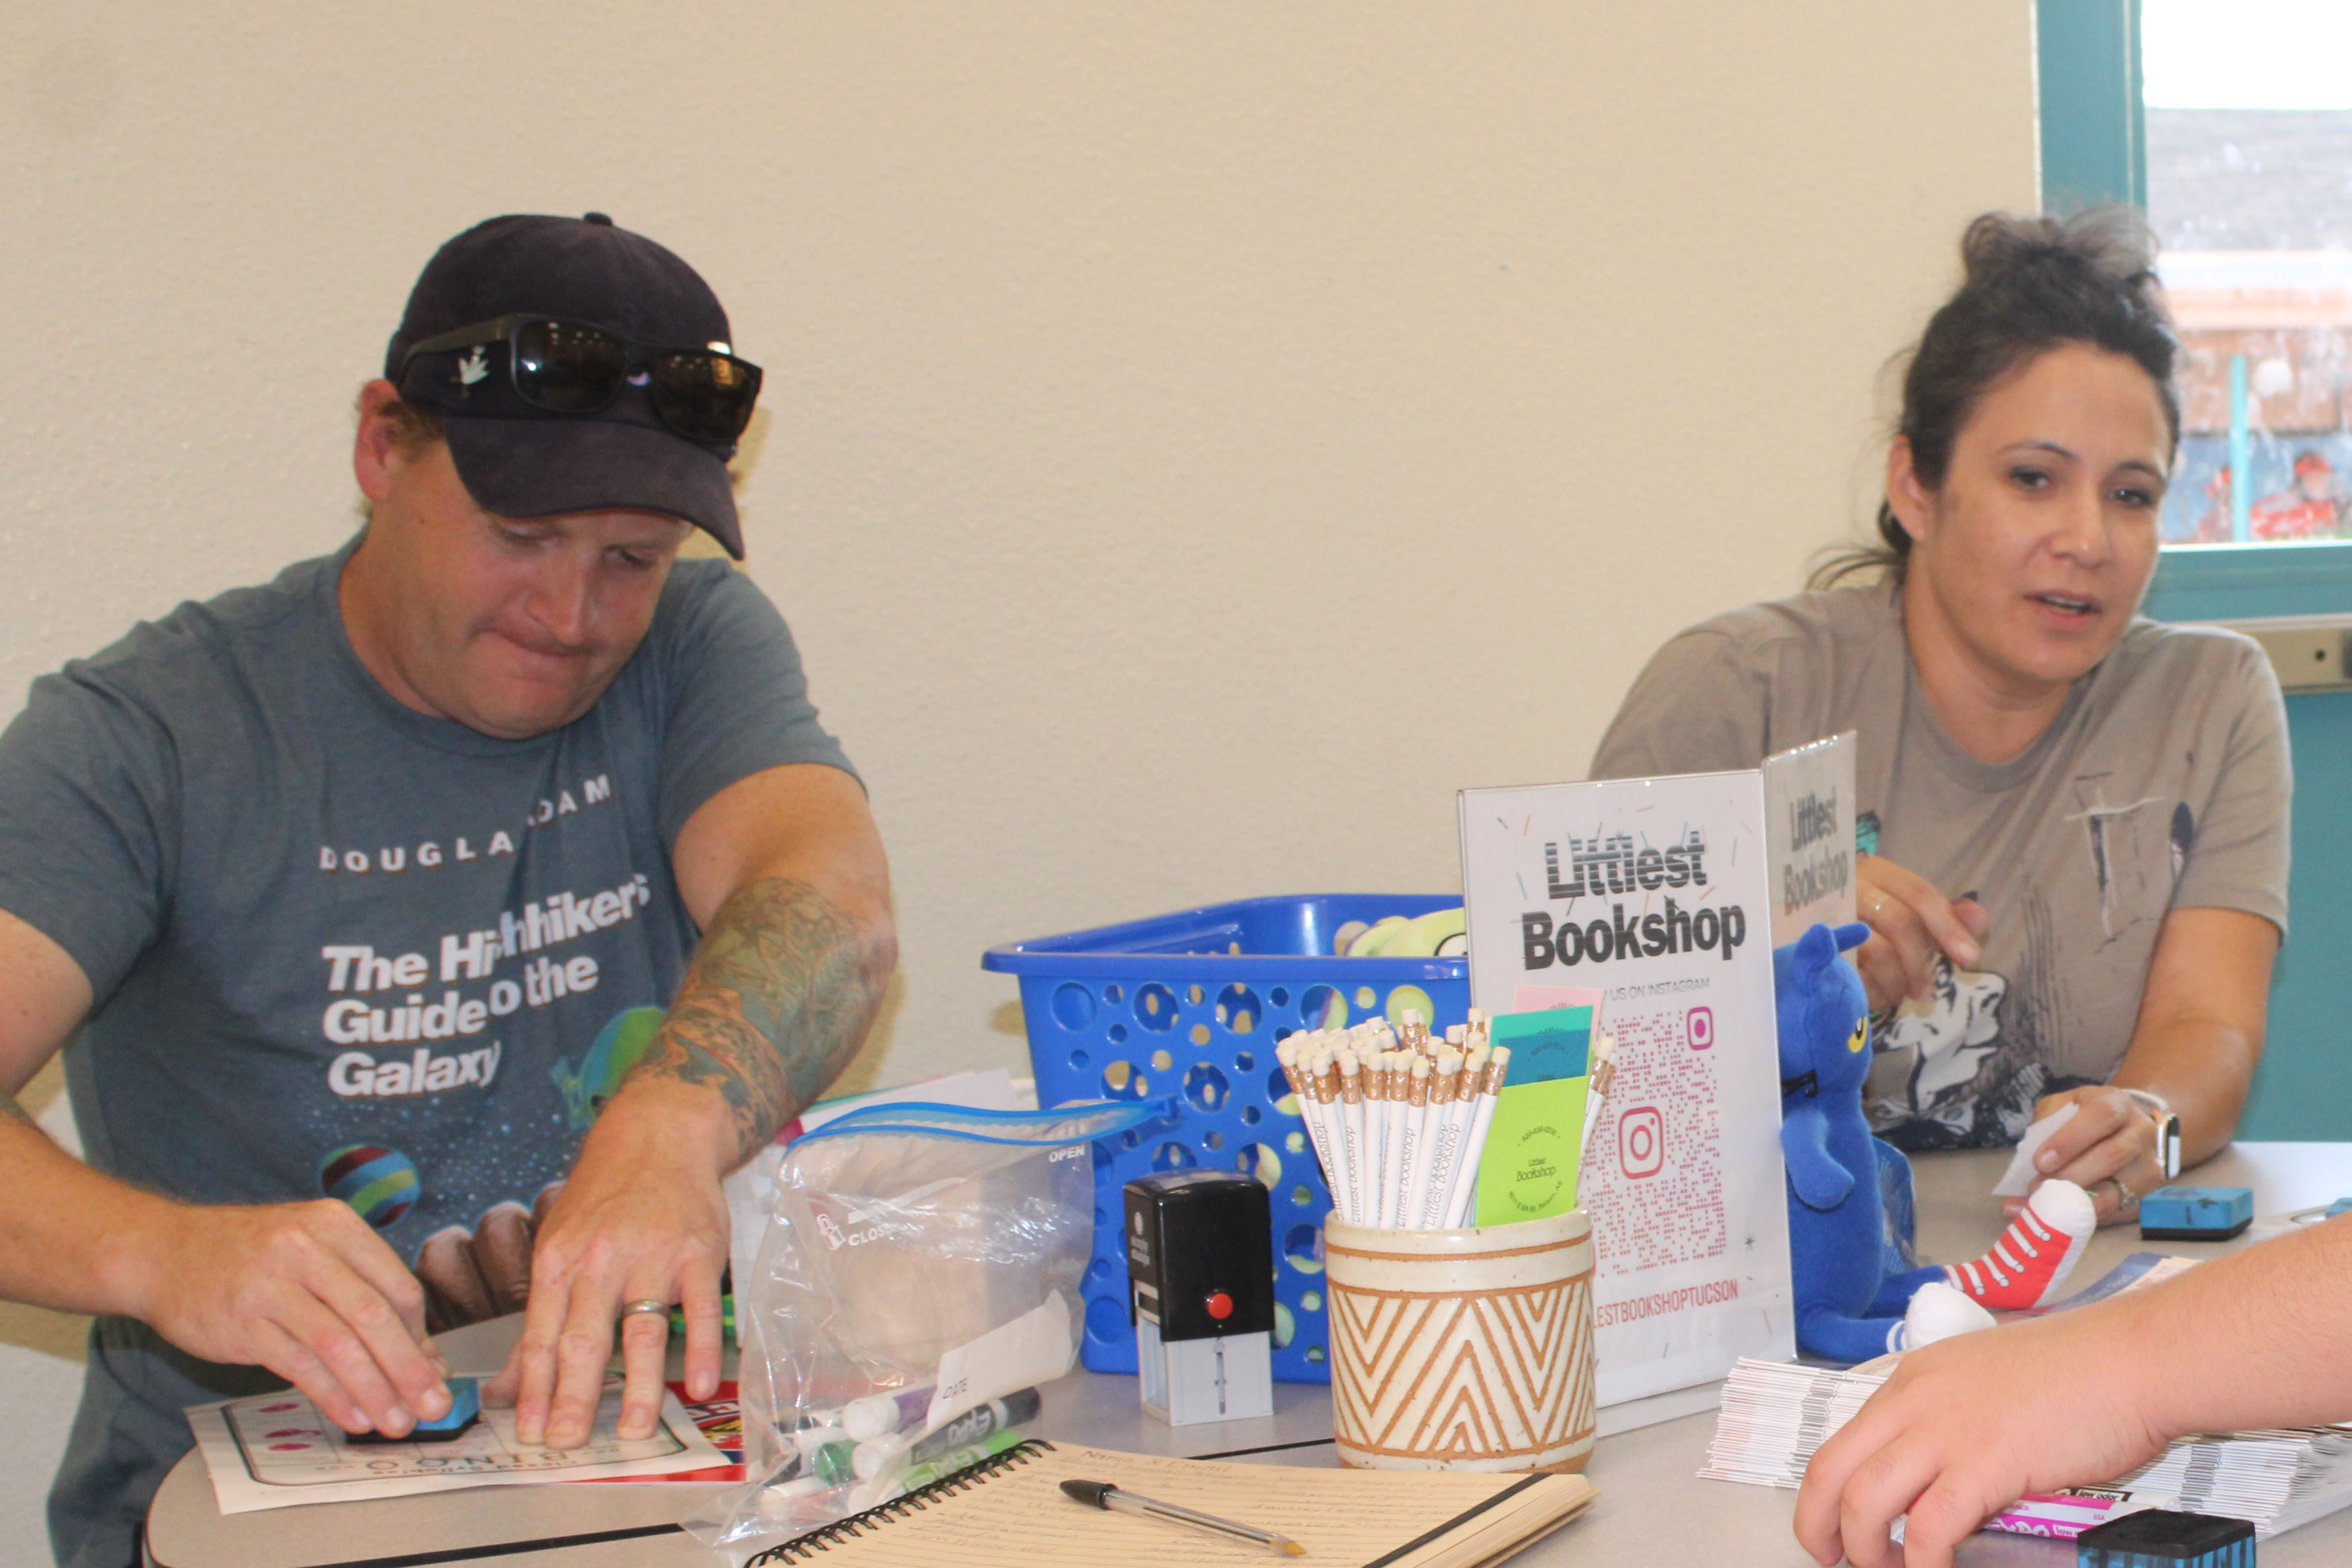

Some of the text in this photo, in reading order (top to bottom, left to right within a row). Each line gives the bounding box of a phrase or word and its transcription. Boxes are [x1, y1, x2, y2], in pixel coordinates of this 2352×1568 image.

[1789, 786, 1837, 853] Littlest
[319, 831, 514, 872] DOUGLA
[1545, 831, 1707, 900] Littlest
[1784, 845, 1848, 916] Bookshop
[1522, 897, 1746, 971] Bookshop
[322, 945, 429, 992] The
[1609, 987, 1627, 1001] US
[1629, 986, 1646, 999] ON
[1648, 977, 1710, 996] INSTAGRAM
[322, 955, 599, 1044] Guide o the
[328, 1040, 502, 1097] Galaxy
[1048, 1145, 1085, 1163] OPEN
[1516, 1166, 1557, 1182] Bookshop
[942, 1377, 968, 1400] DATE
[2097, 1492, 2118, 1501] odor
